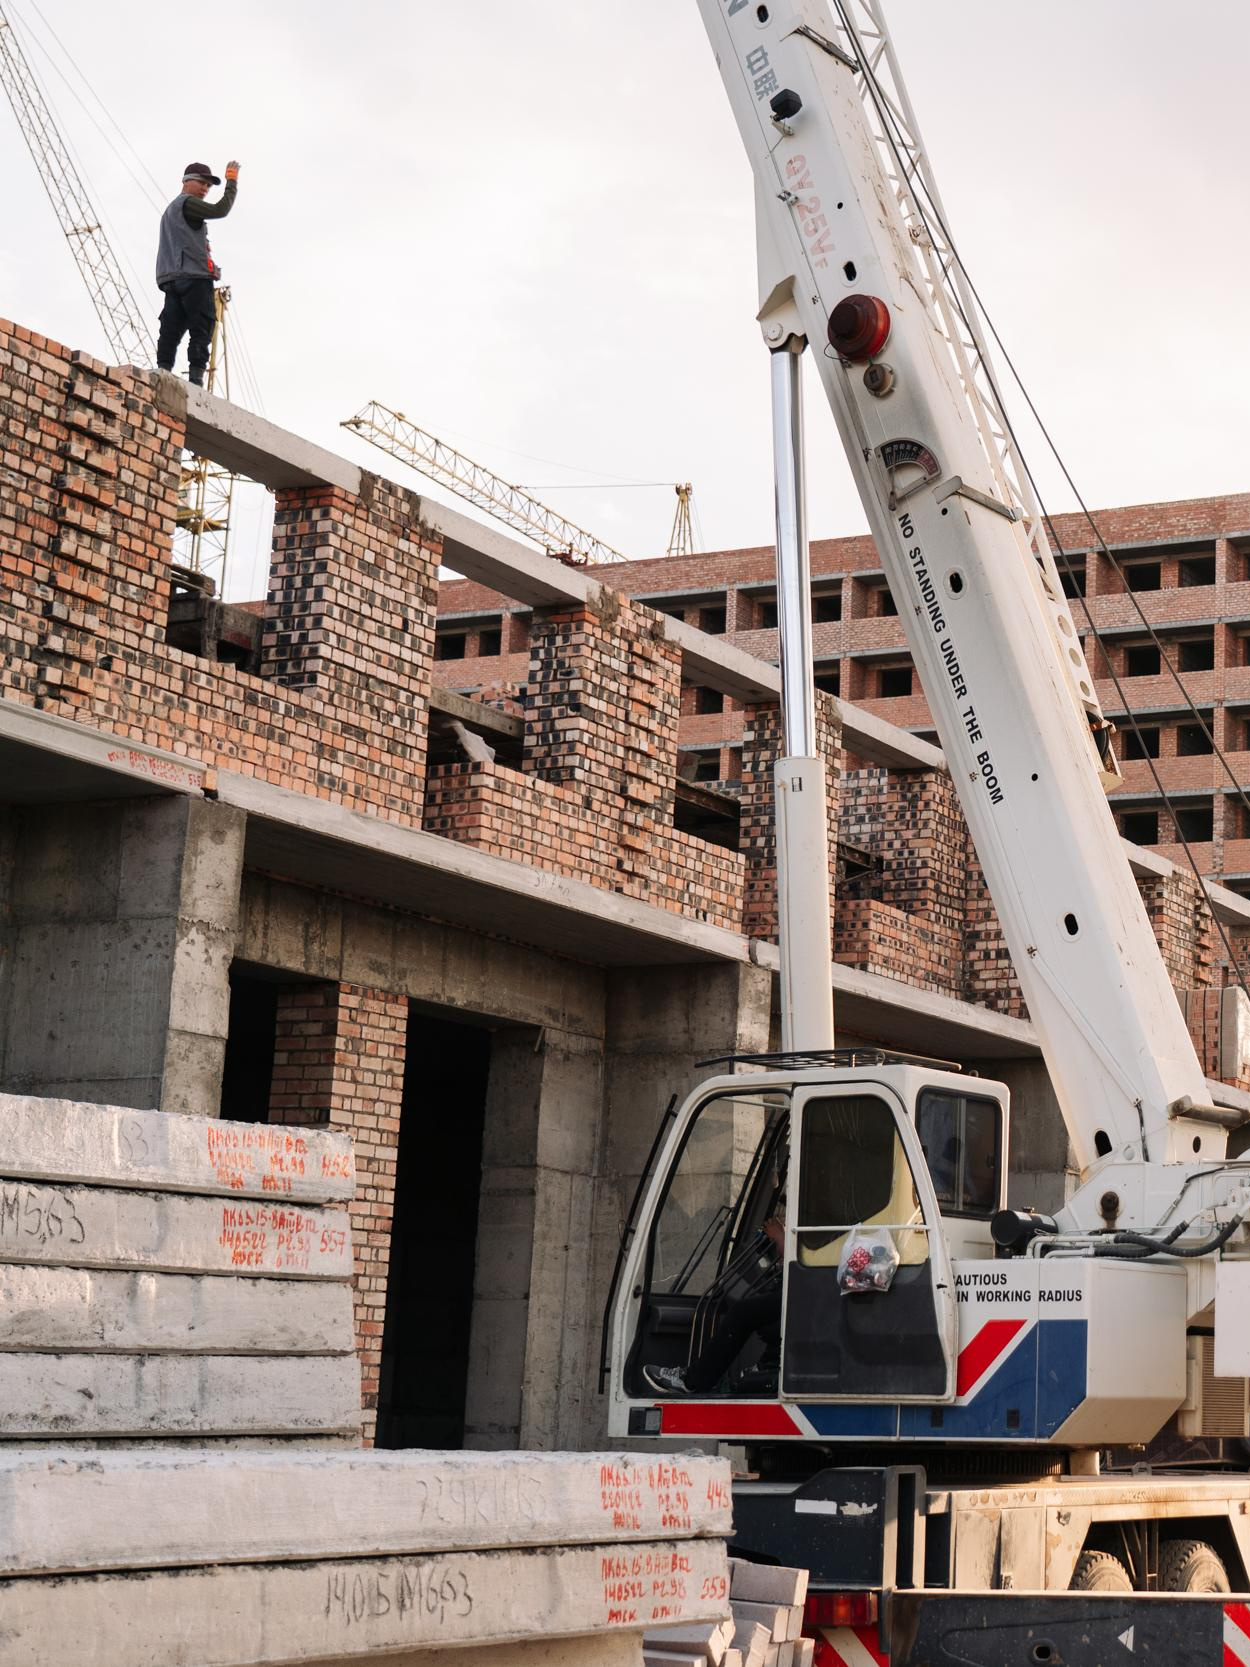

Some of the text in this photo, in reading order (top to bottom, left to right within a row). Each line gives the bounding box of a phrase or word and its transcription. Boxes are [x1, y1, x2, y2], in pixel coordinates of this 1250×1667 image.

[898, 512, 1004, 805] NO STANDING UNDER THE BOOM
[976, 1290, 1032, 1303] WORKING
[1038, 1289, 1083, 1303] RADIUS
